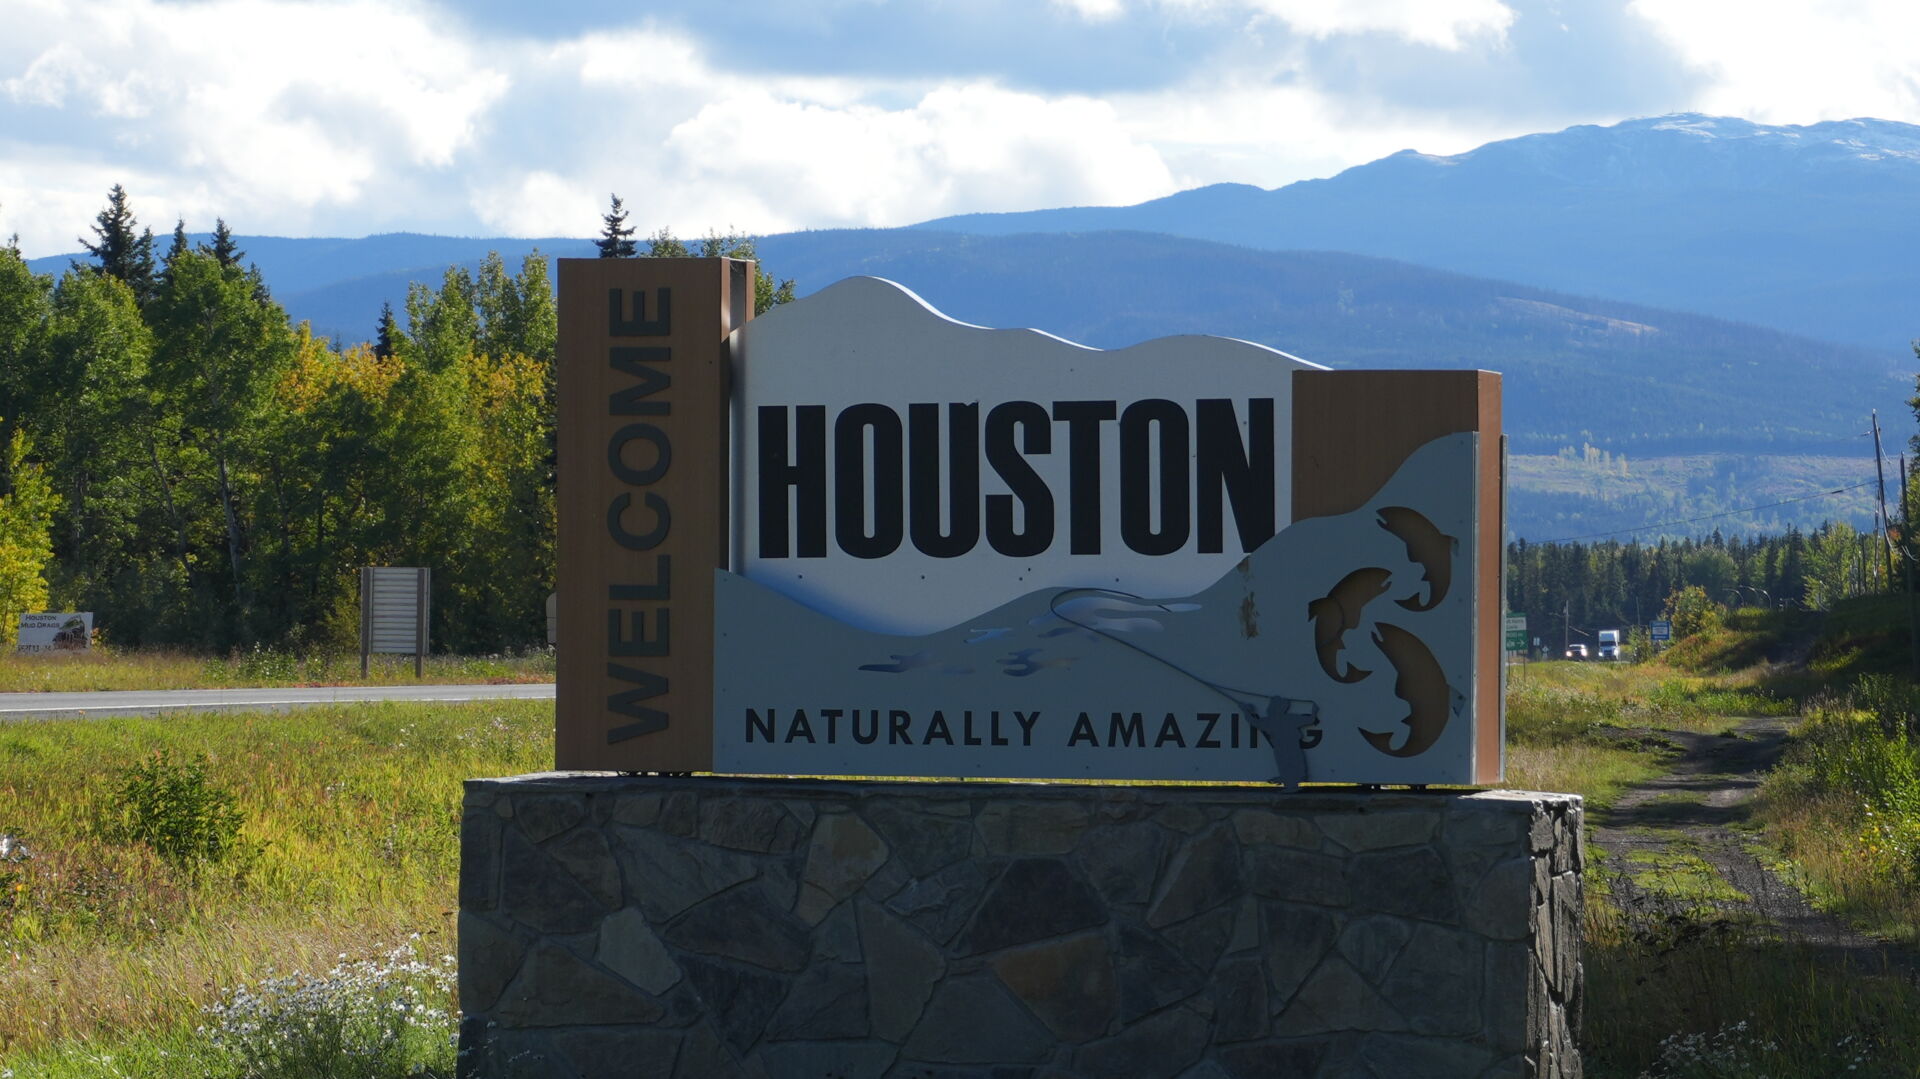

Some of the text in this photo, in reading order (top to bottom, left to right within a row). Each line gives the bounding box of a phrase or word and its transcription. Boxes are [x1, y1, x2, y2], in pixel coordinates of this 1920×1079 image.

[607, 287, 671, 744] WELCOME
[758, 398, 1275, 559] HOUSTON
[745, 708, 1041, 747] NATURALLY
